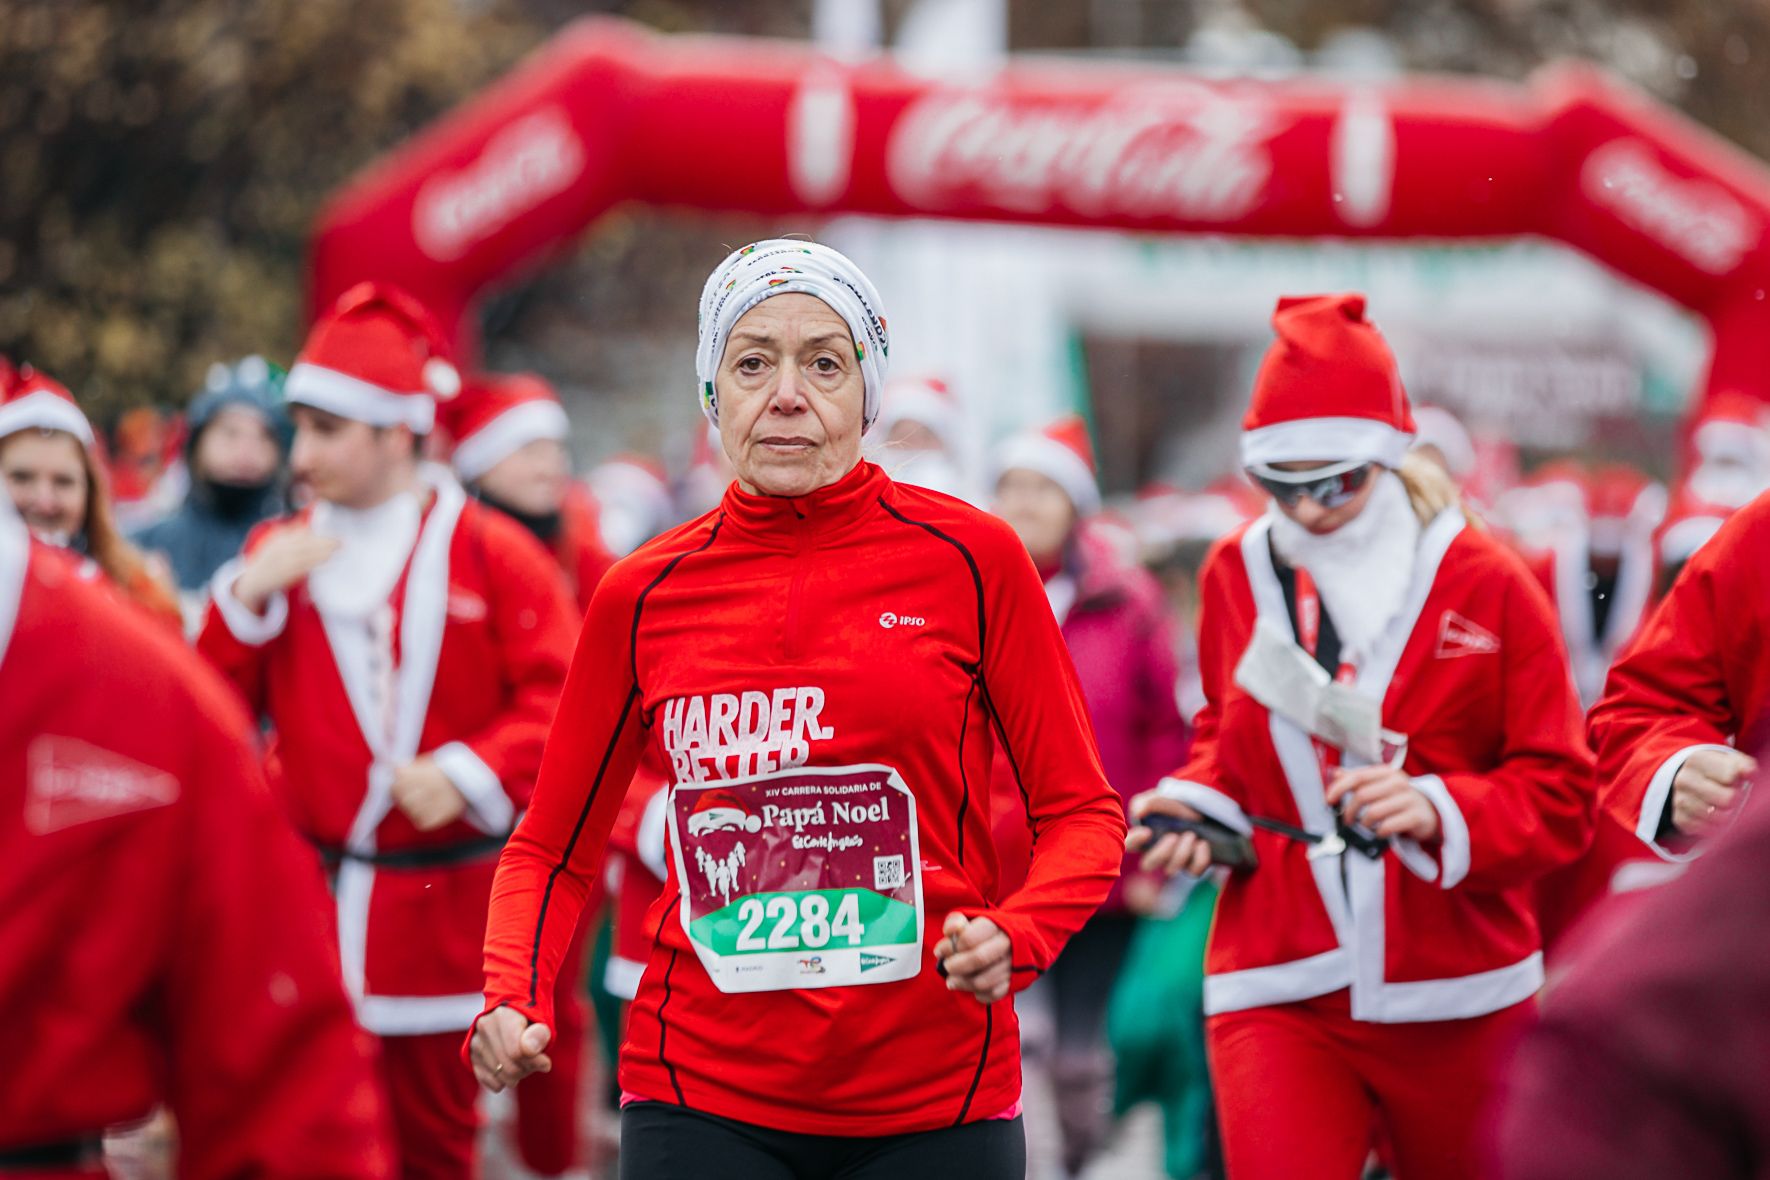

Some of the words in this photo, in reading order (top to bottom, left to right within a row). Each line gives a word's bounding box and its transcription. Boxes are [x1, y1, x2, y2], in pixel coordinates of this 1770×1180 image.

[663, 686, 835, 752] HARDER.
[765, 788, 780, 798] XIV
[781, 785, 822, 796] CARRERA
[823, 783, 869, 795] SOLIDARIA
[869, 782, 882, 791] DE
[761, 800, 827, 833] Papá
[831, 796, 891, 825] Noel
[735, 893, 865, 951] 2284
